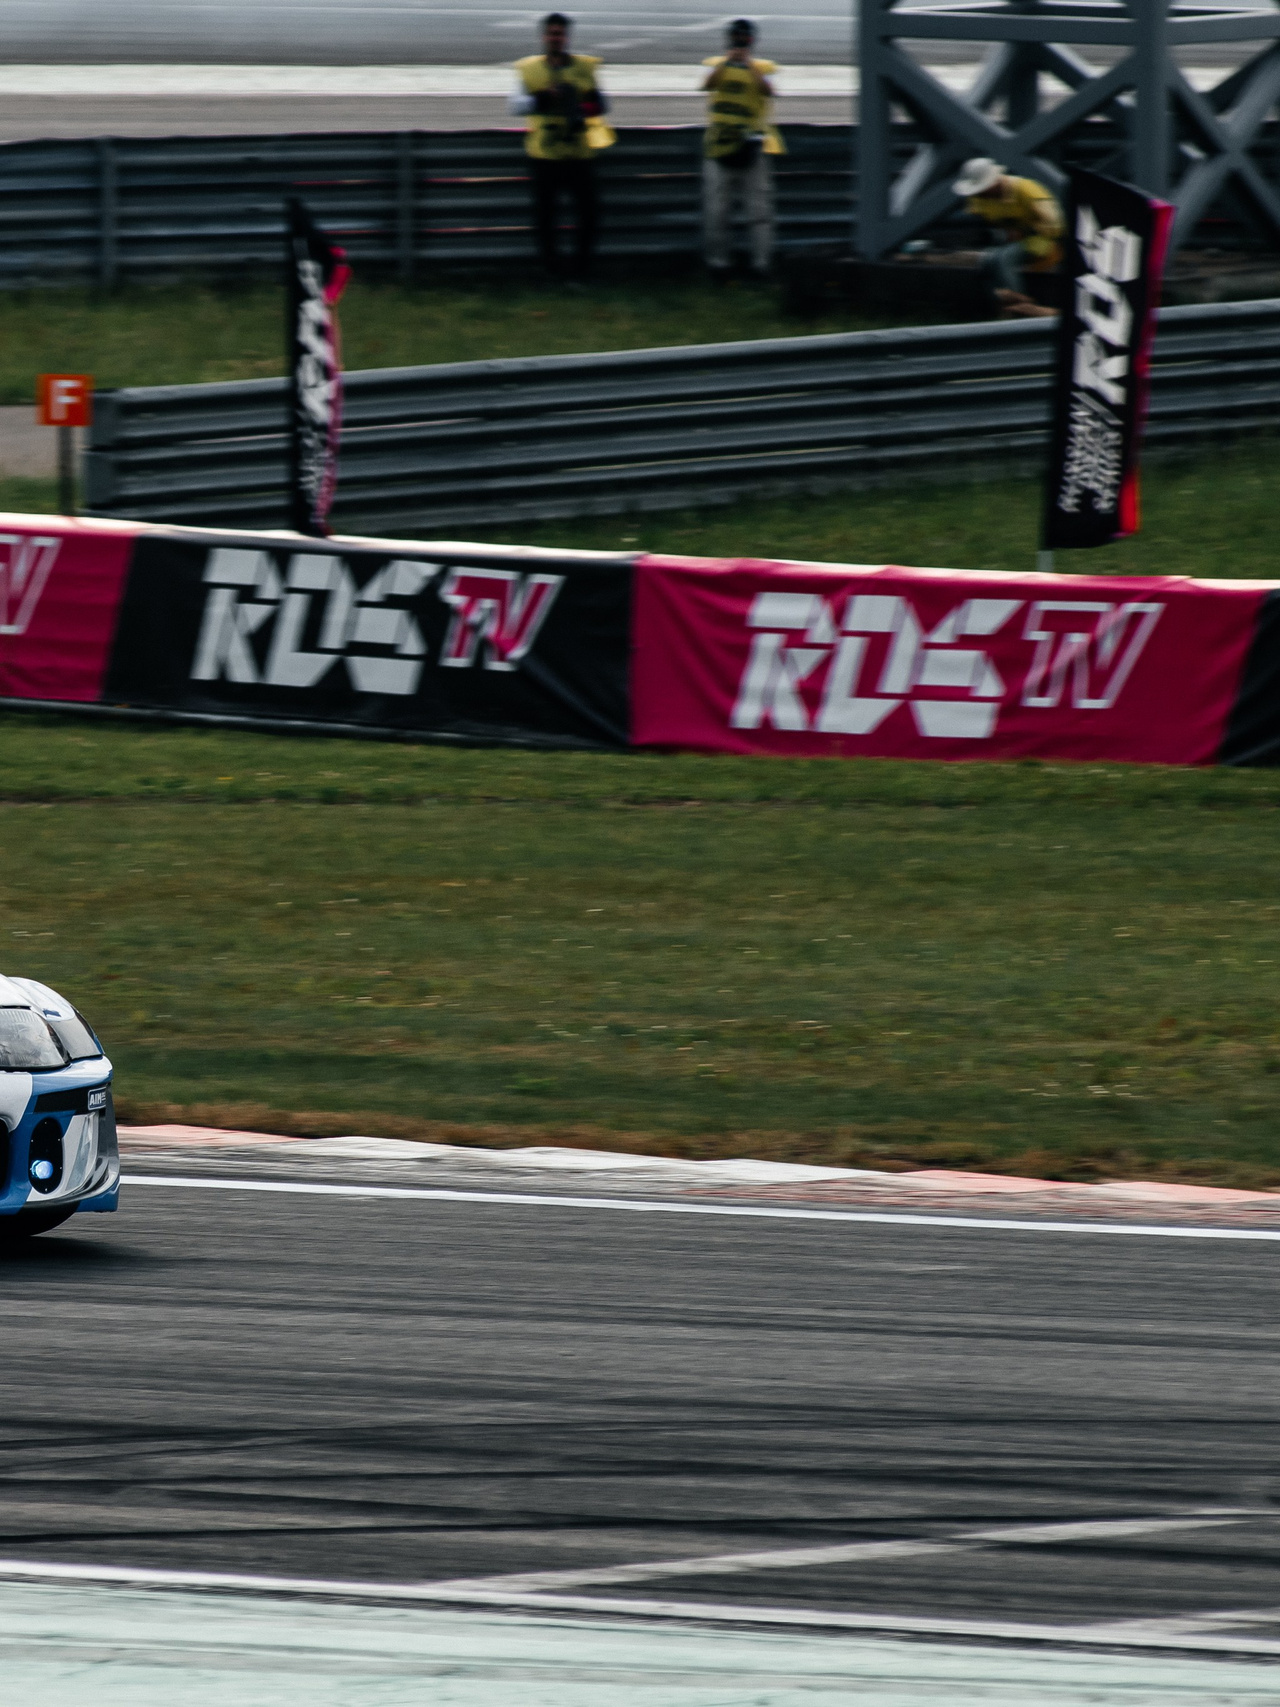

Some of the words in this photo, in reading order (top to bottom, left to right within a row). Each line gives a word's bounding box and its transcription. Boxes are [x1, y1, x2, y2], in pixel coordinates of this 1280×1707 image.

[1072, 204, 1142, 404] RDS
[50, 379, 82, 420] F
[189, 547, 444, 695] RDS
[438, 565, 567, 671] TV
[728, 591, 1024, 738] RDS
